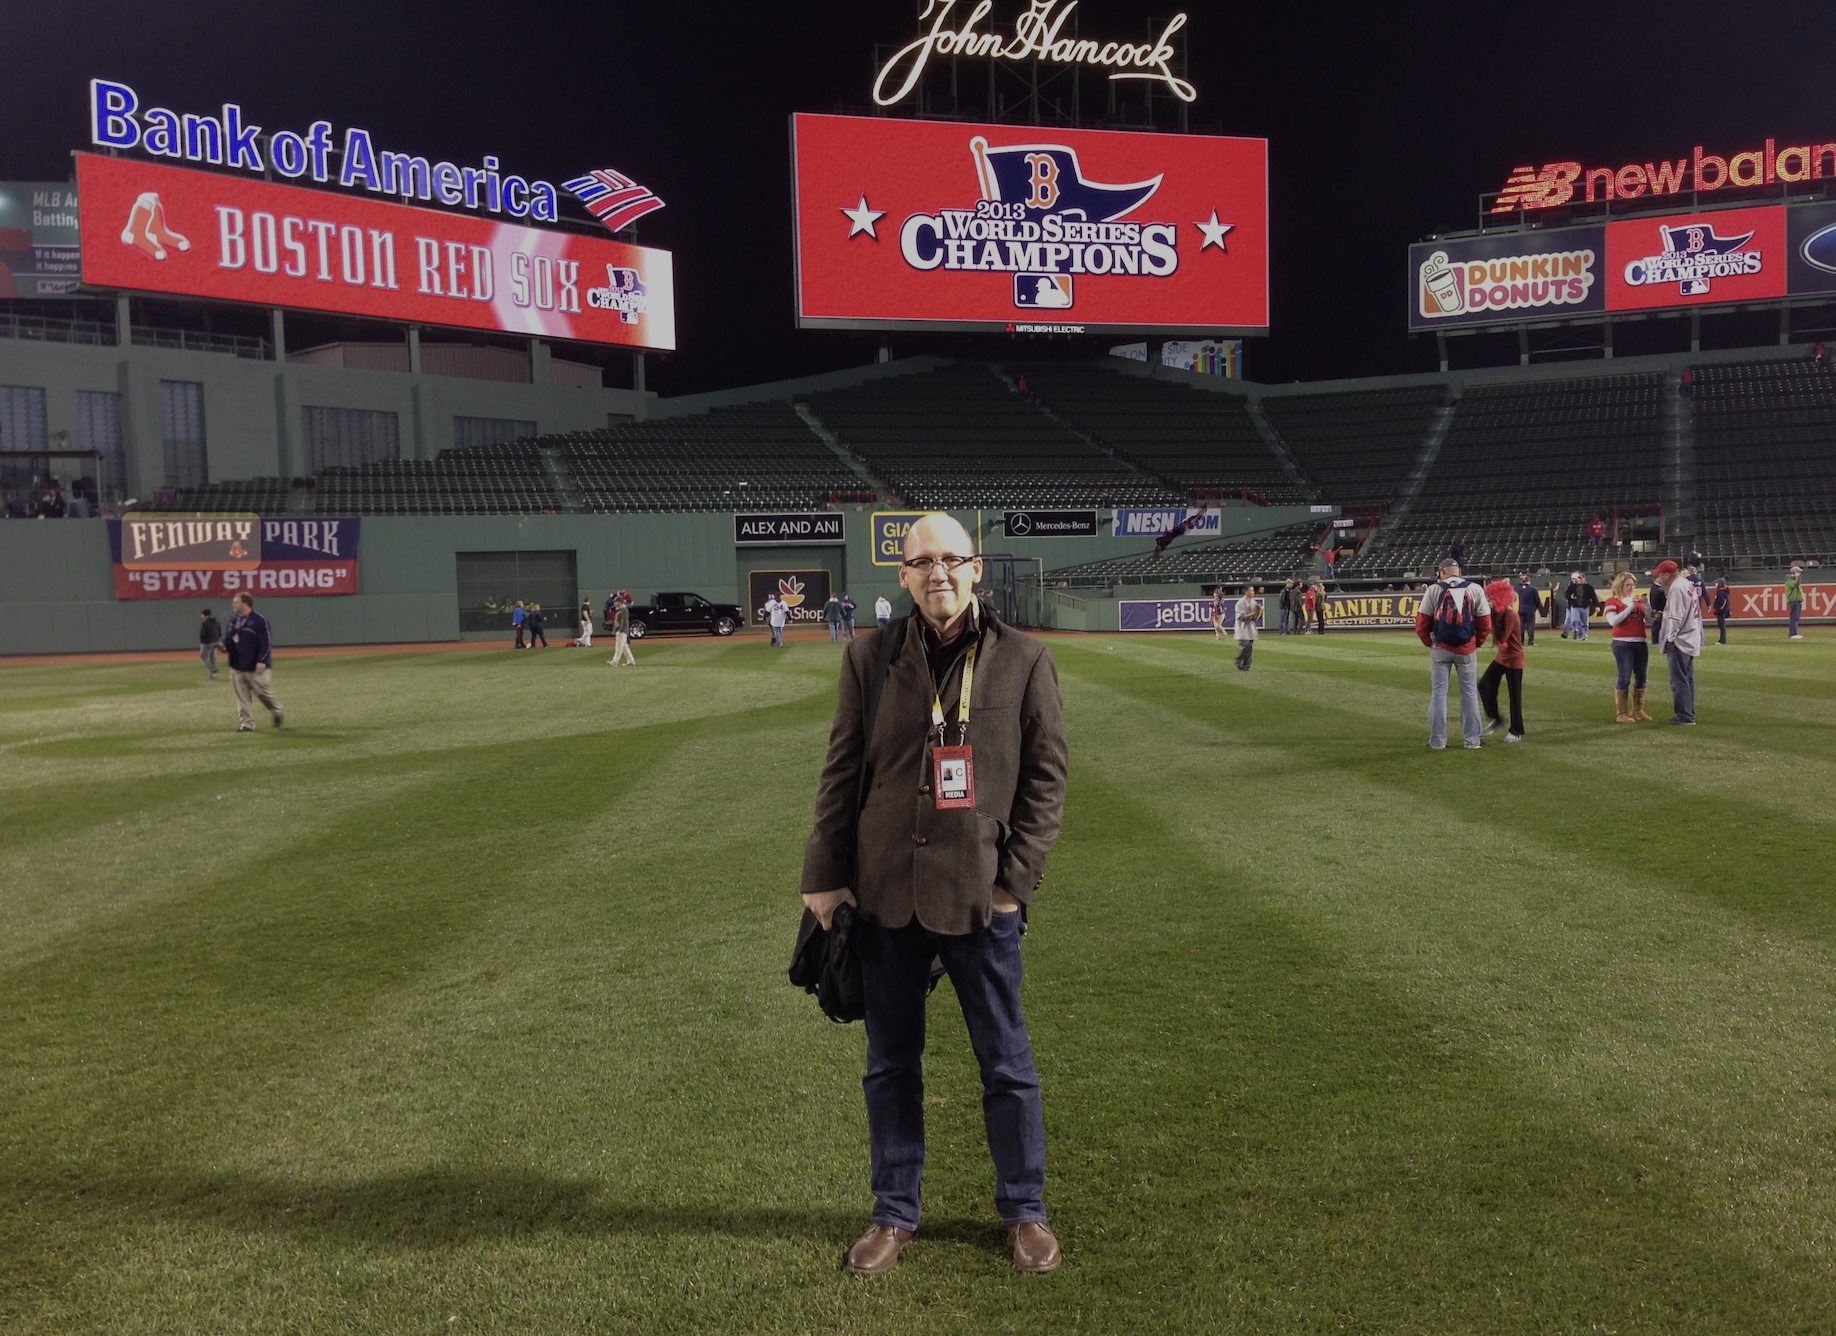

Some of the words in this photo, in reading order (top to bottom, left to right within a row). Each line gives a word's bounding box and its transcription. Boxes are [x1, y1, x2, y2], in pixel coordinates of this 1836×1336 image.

[873, 0, 1002, 105] John
[1002, 0, 1197, 102] Hancock
[90, 78, 264, 172] Bank
[270, 120, 332, 182] of
[340, 128, 558, 222] America
[1024, 153, 1060, 209] B
[1586, 158, 1687, 204] new
[1693, 137, 1836, 192] balan
[33, 191, 61, 208] MLB
[976, 200, 1026, 220] 2013
[941, 210, 1040, 241] WORLD
[1041, 213, 1141, 245] SERIES
[1686, 228, 1704, 252] B
[900, 213, 1178, 277] CHAMPIONS
[1662, 250, 1688, 260] 2013
[215, 204, 400, 290] BOSTON
[415, 235, 495, 302] RED
[510, 250, 582, 314] SOX
[1469, 254, 1590, 286] DUNKIN'
[1624, 250, 1762, 286] CHAMPIONS
[1643, 256, 1695, 270] WORLD
[1694, 252, 1744, 266] SERIES
[1469, 278, 1583, 308] DONUTS
[1015, 325, 1052, 333] MITSUBISHI
[1053, 325, 1085, 334] ELECTRIC
[741, 521, 776, 535] ALEX
[779, 520, 811, 534] AND
[814, 520, 839, 533] ANI
[883, 522, 910, 538] GIA
[1035, 521, 1091, 531] Mercedes-Benz
[1127, 512, 1176, 533] NESN
[130, 521, 252, 560] FENWAY
[264, 520, 340, 556] PARK
[1155, 601, 1212, 628] jetBlu
[955, 767, 963, 777] C
[945, 791, 965, 799] MEDIA
